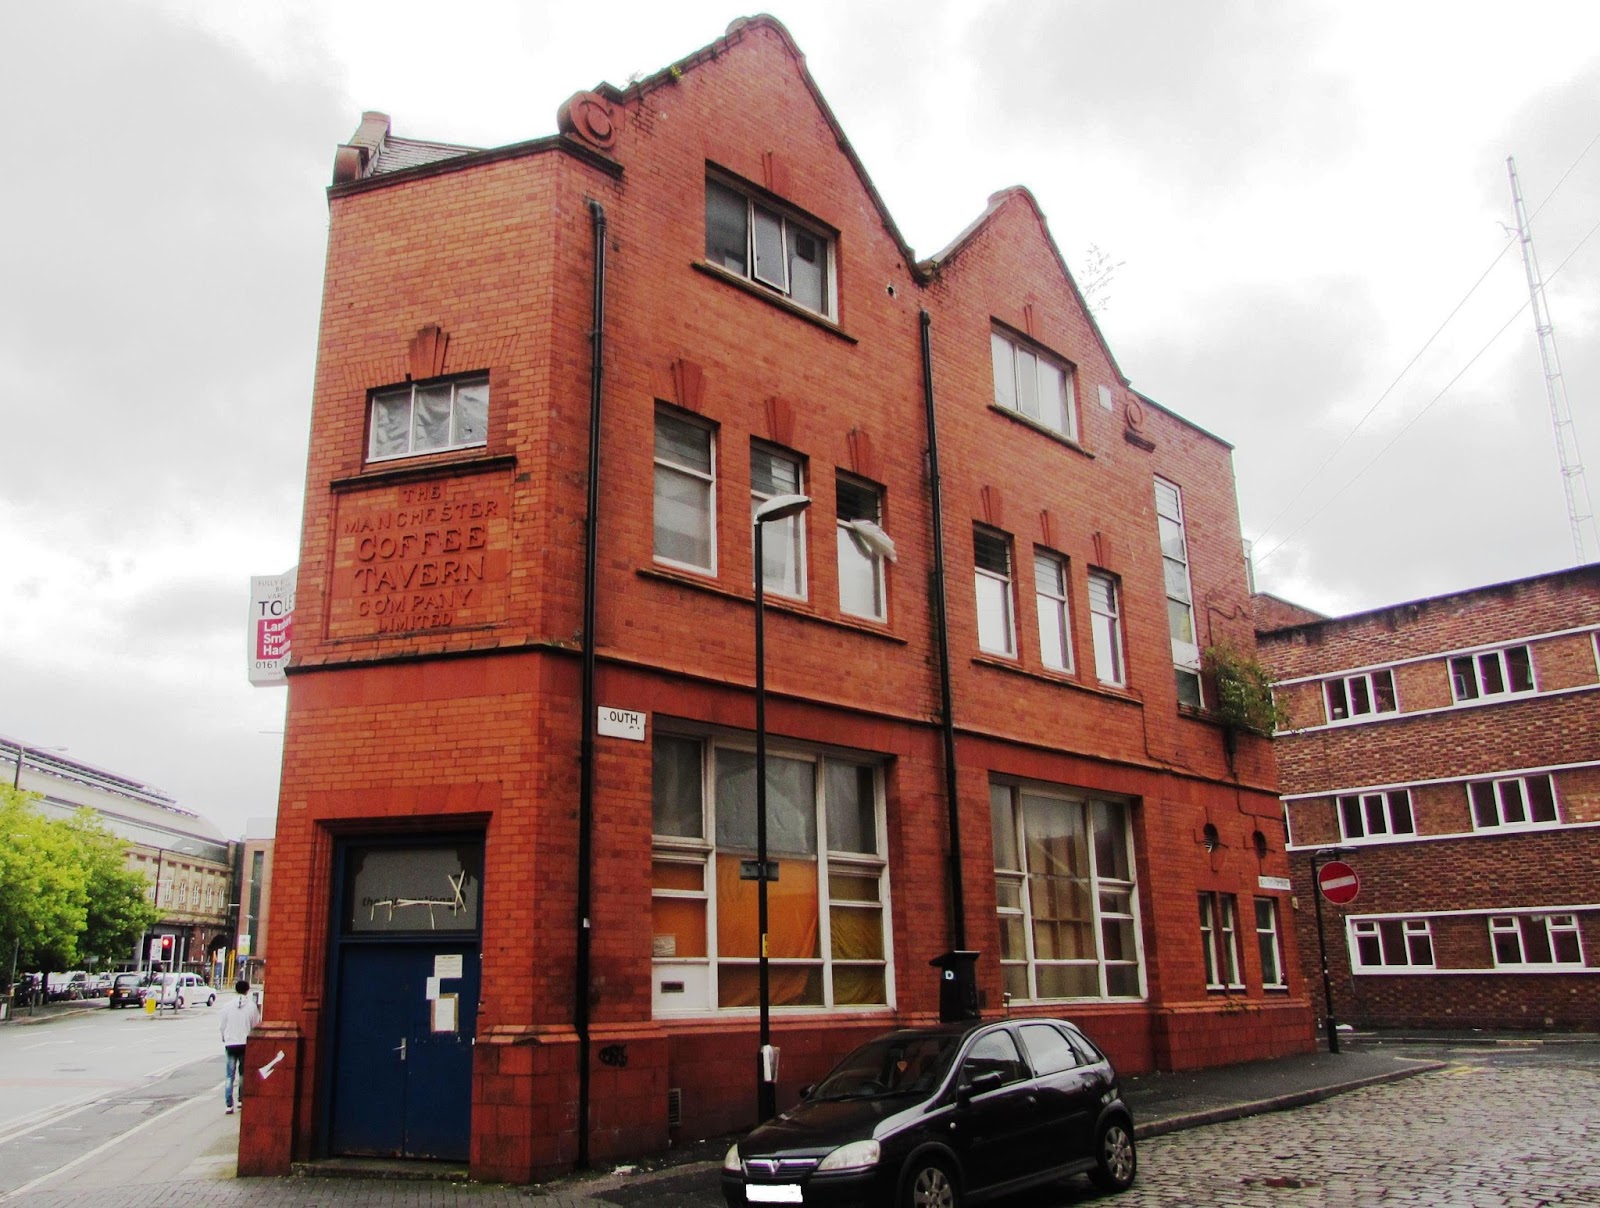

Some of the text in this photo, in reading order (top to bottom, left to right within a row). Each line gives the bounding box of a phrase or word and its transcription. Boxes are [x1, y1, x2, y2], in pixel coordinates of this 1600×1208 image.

[403, 485, 441, 502] THE
[345, 501, 498, 533] MANCHESTER
[359, 526, 486, 562] COFFEE
[355, 556, 485, 593] TAVERN
[258, 600, 282, 616] TO
[359, 589, 473, 617] COMPANY
[378, 613, 453, 633] LIMITED
[255, 661, 278, 669] 0161
[603, 710, 638, 725] OUTH
